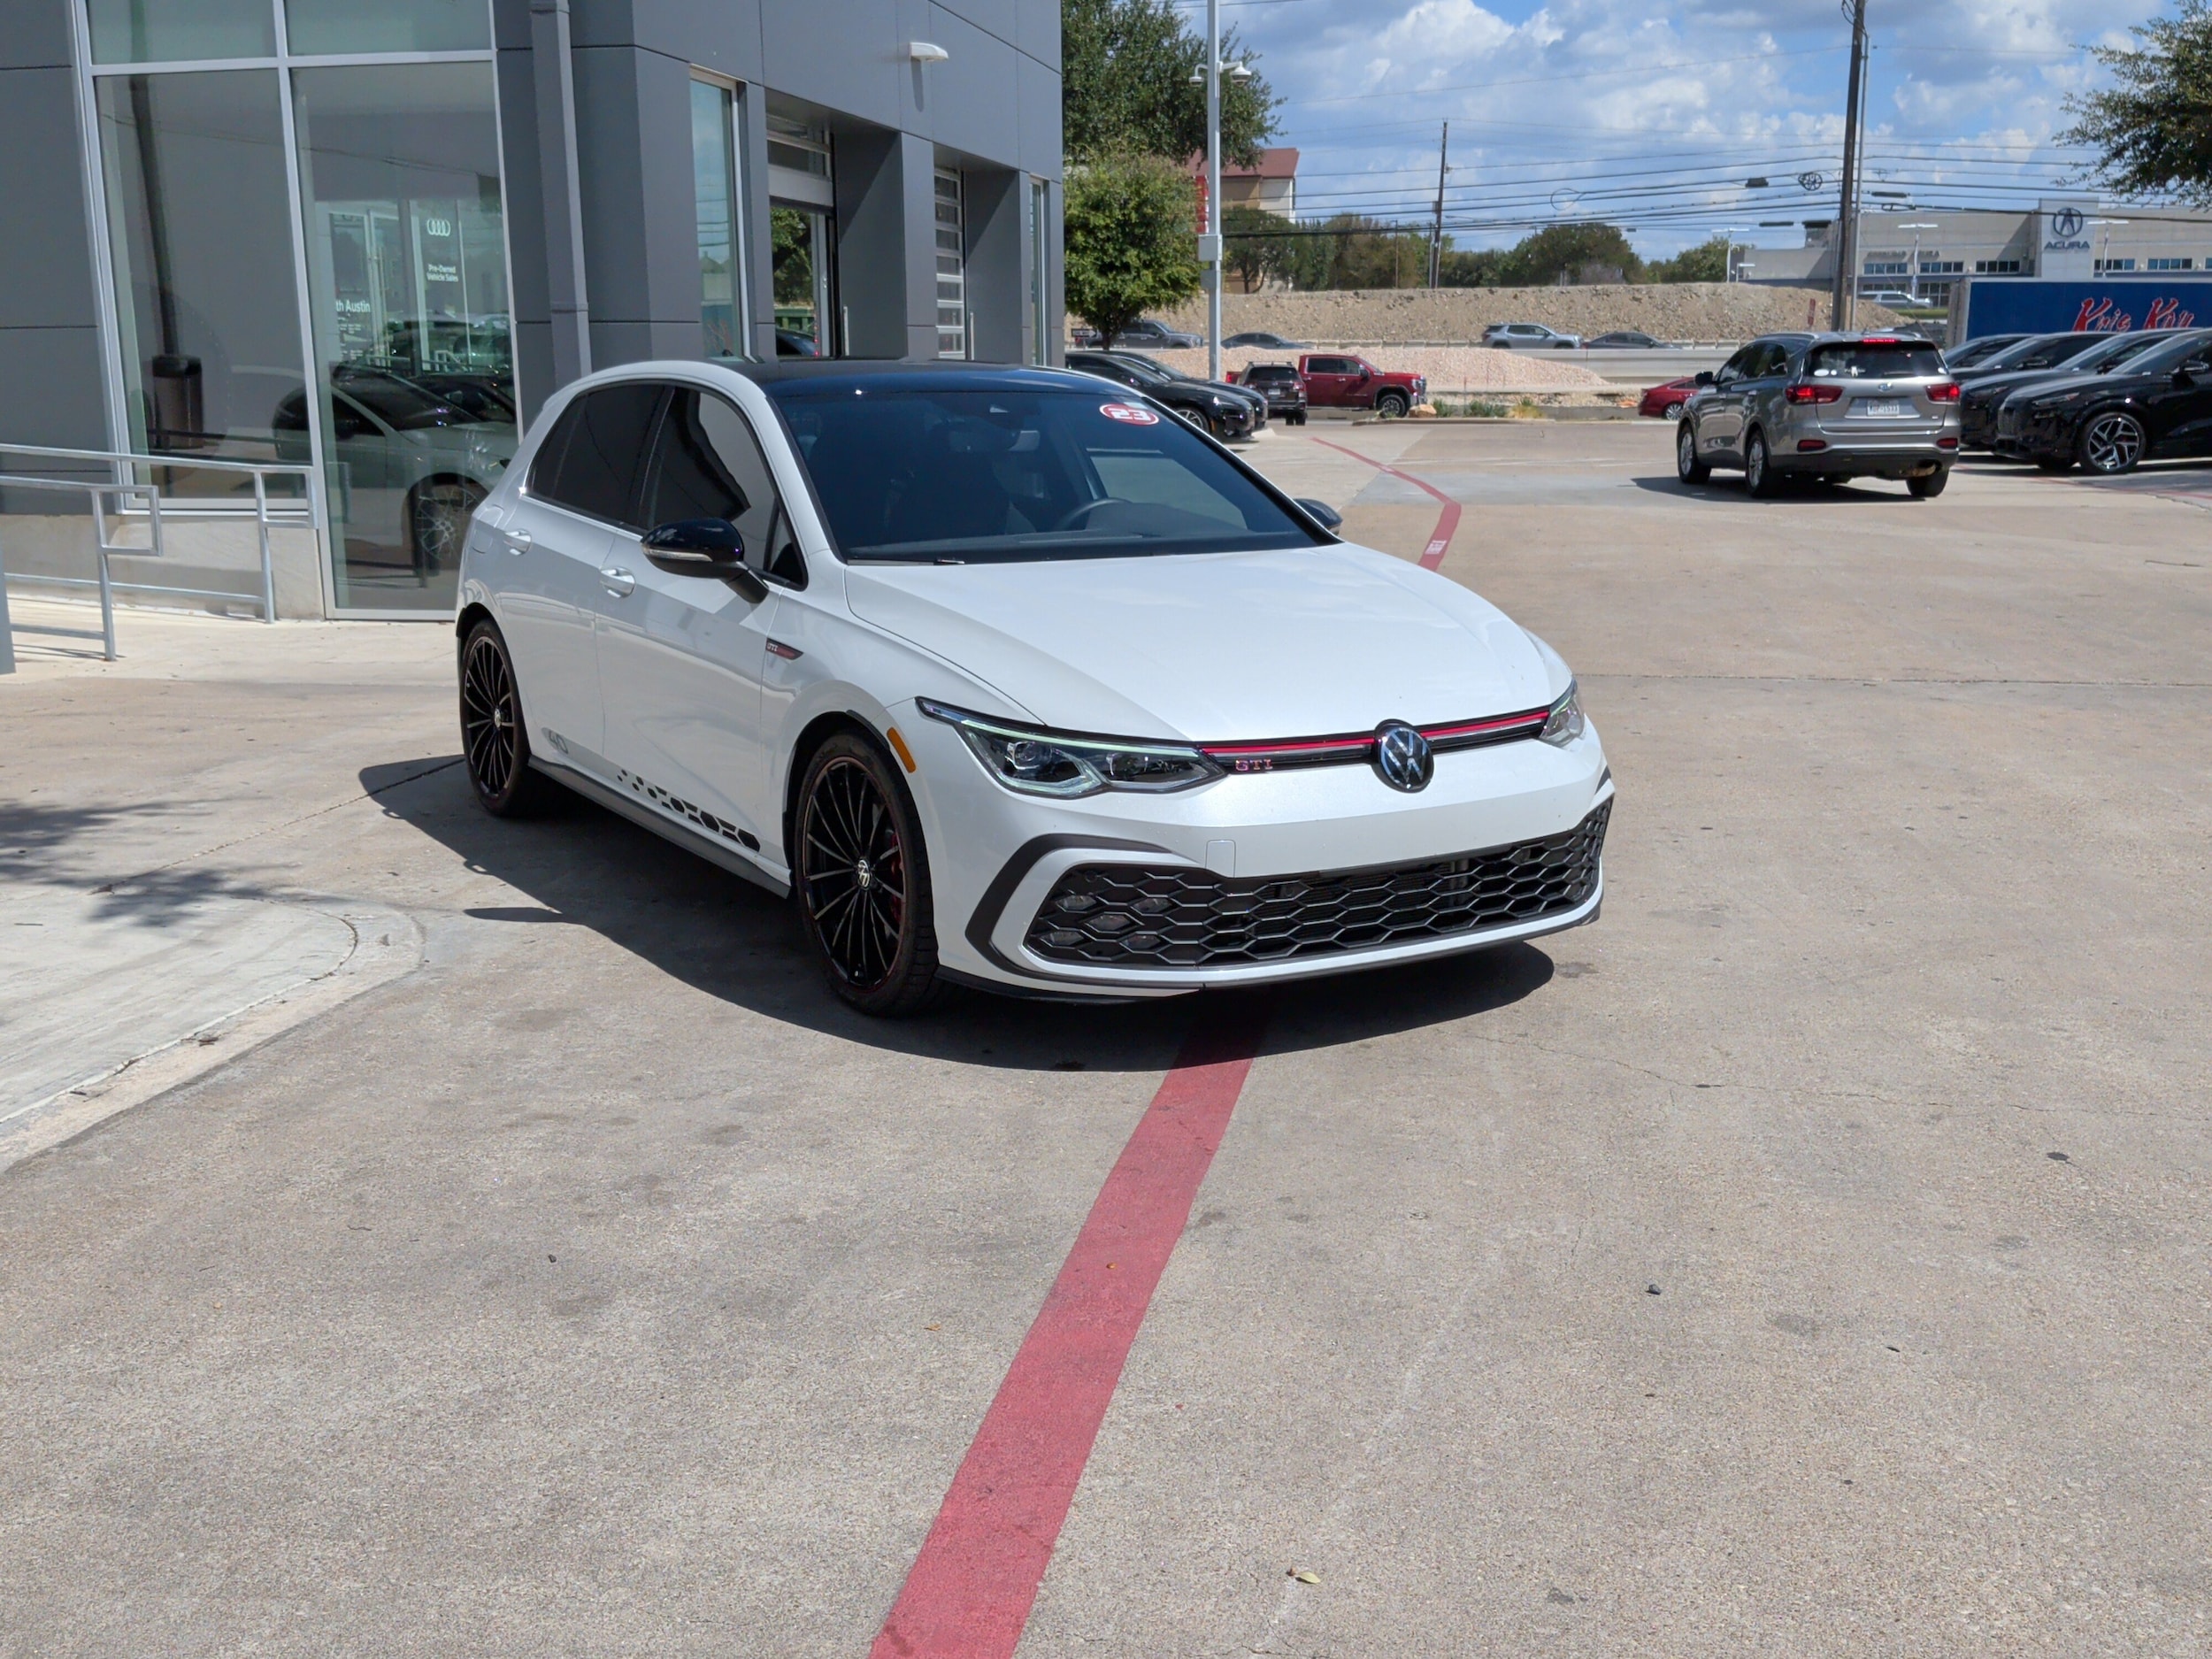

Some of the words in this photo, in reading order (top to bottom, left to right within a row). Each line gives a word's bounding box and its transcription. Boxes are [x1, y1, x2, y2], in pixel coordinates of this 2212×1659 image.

[2045, 241, 2090, 250] ACURA
[346, 299, 371, 312] Austin
[1109, 408, 1151, 421] 23
[1235, 759, 1273, 772] GTI
